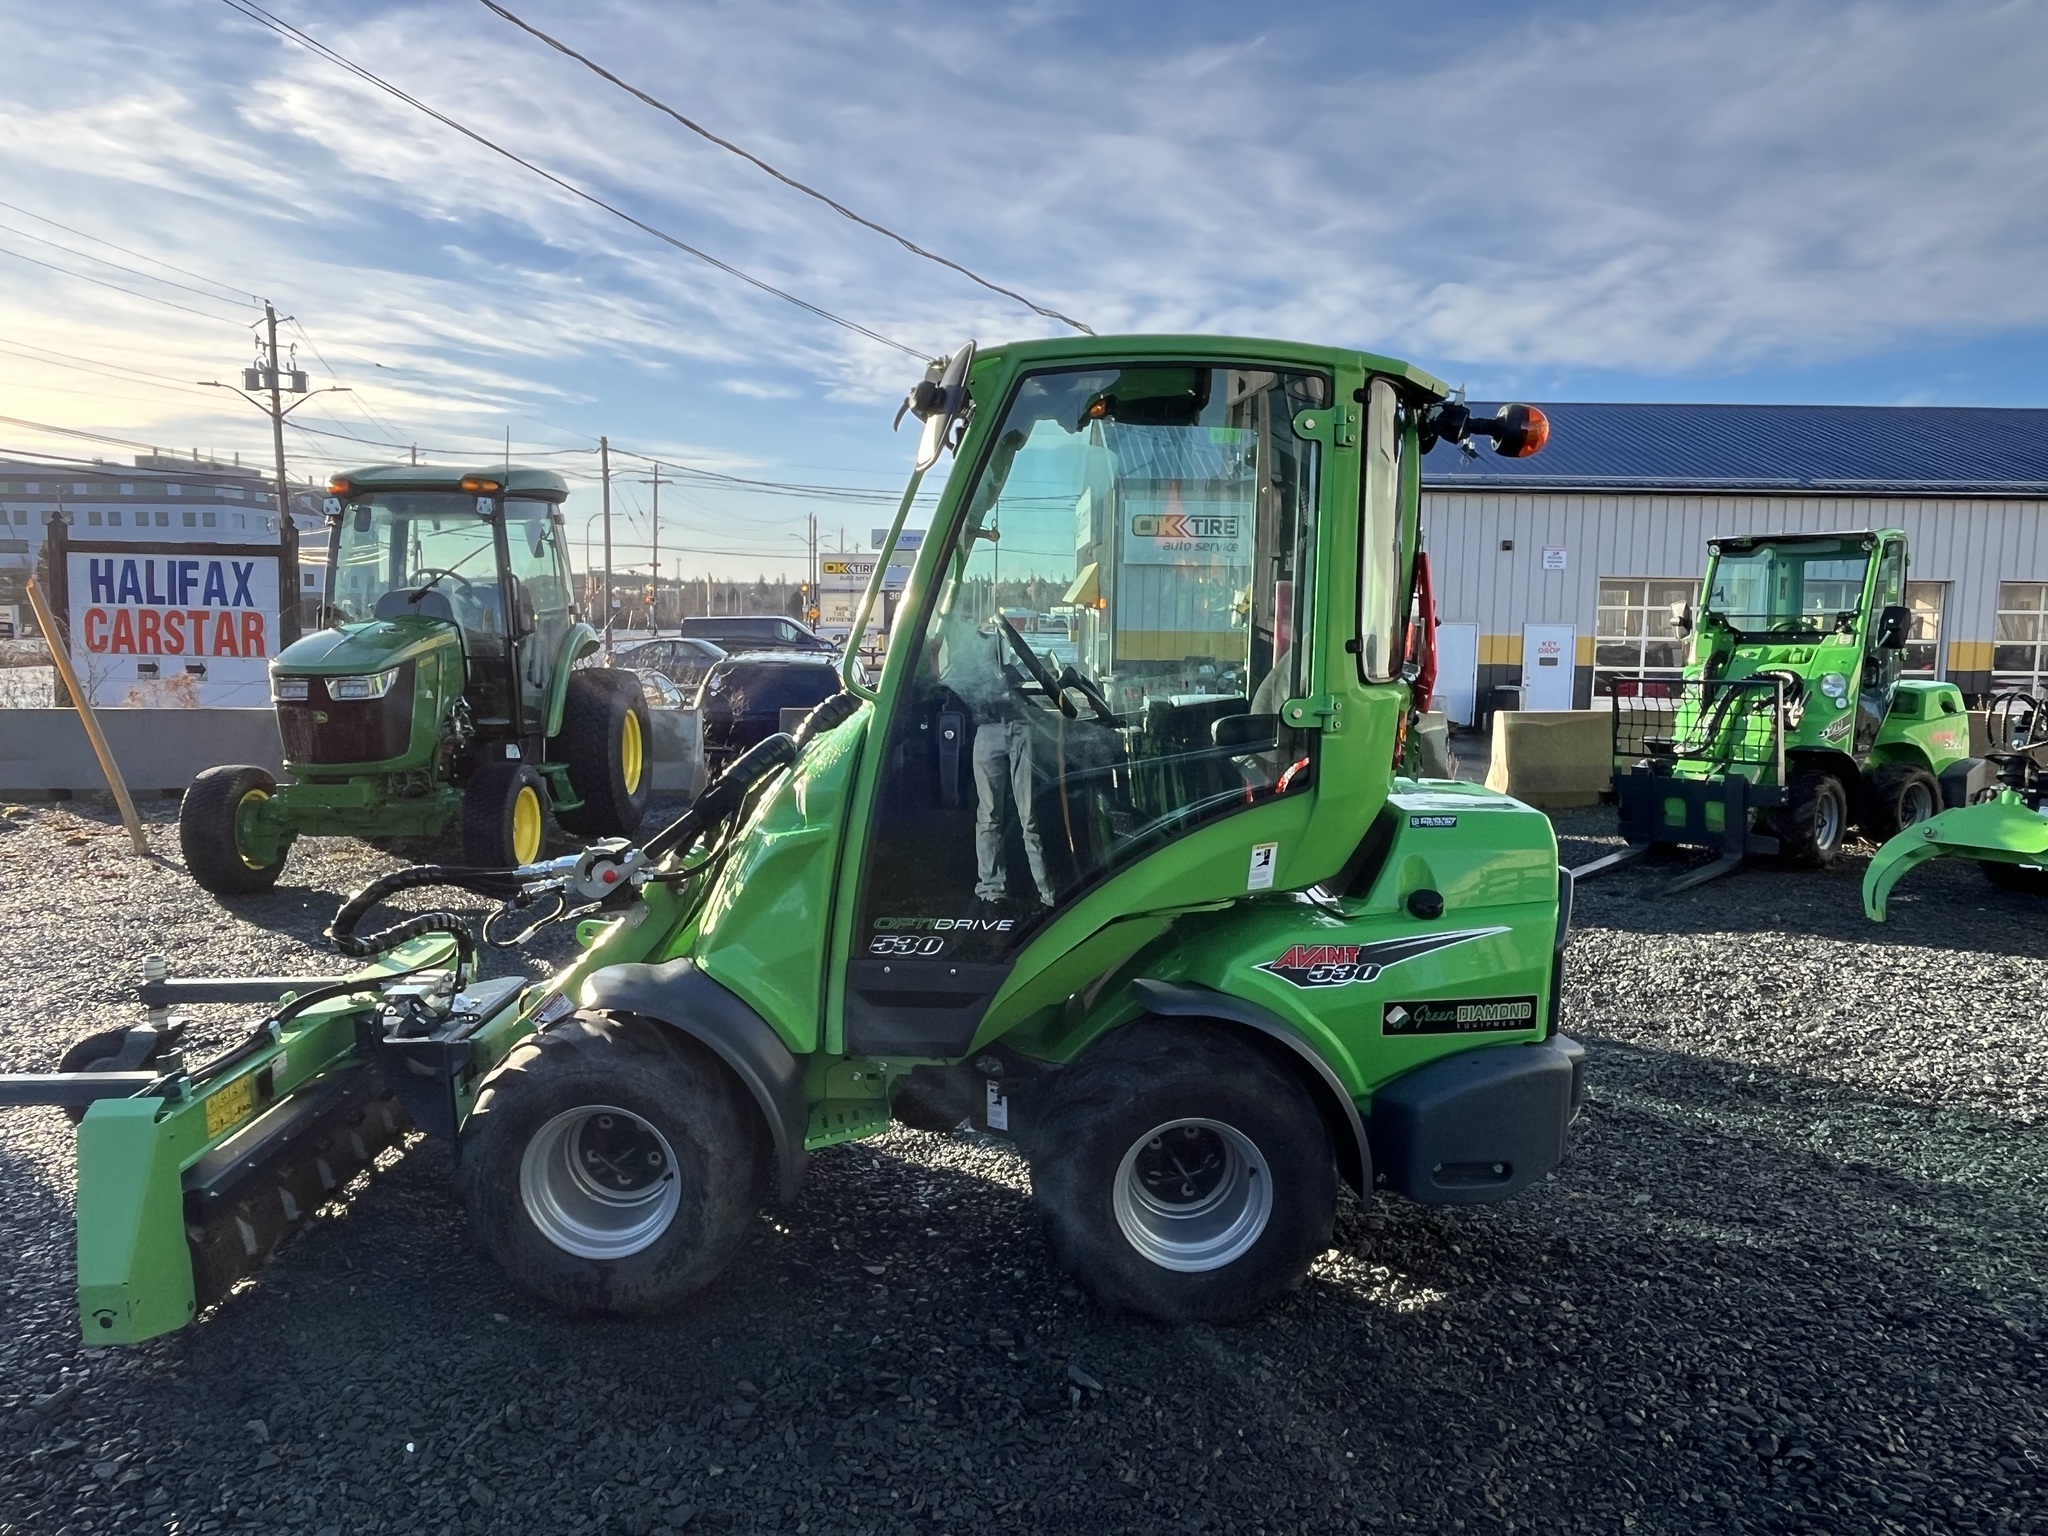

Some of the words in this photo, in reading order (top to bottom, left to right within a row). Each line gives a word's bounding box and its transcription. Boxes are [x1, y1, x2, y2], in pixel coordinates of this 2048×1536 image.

[1132, 514, 1185, 537] OK
[1190, 518, 1236, 535] TIRE
[1163, 541, 1192, 551] auto
[1195, 541, 1239, 552] service
[89, 558, 255, 607] HALIFAX
[84, 607, 266, 658] CARSTAR
[873, 916, 1015, 931] OPTIDRIVE
[868, 934, 945, 956] 530
[1269, 944, 1361, 969] AVANT
[1306, 962, 1382, 983] 530
[1456, 1002, 1532, 1023] DIAMOND
